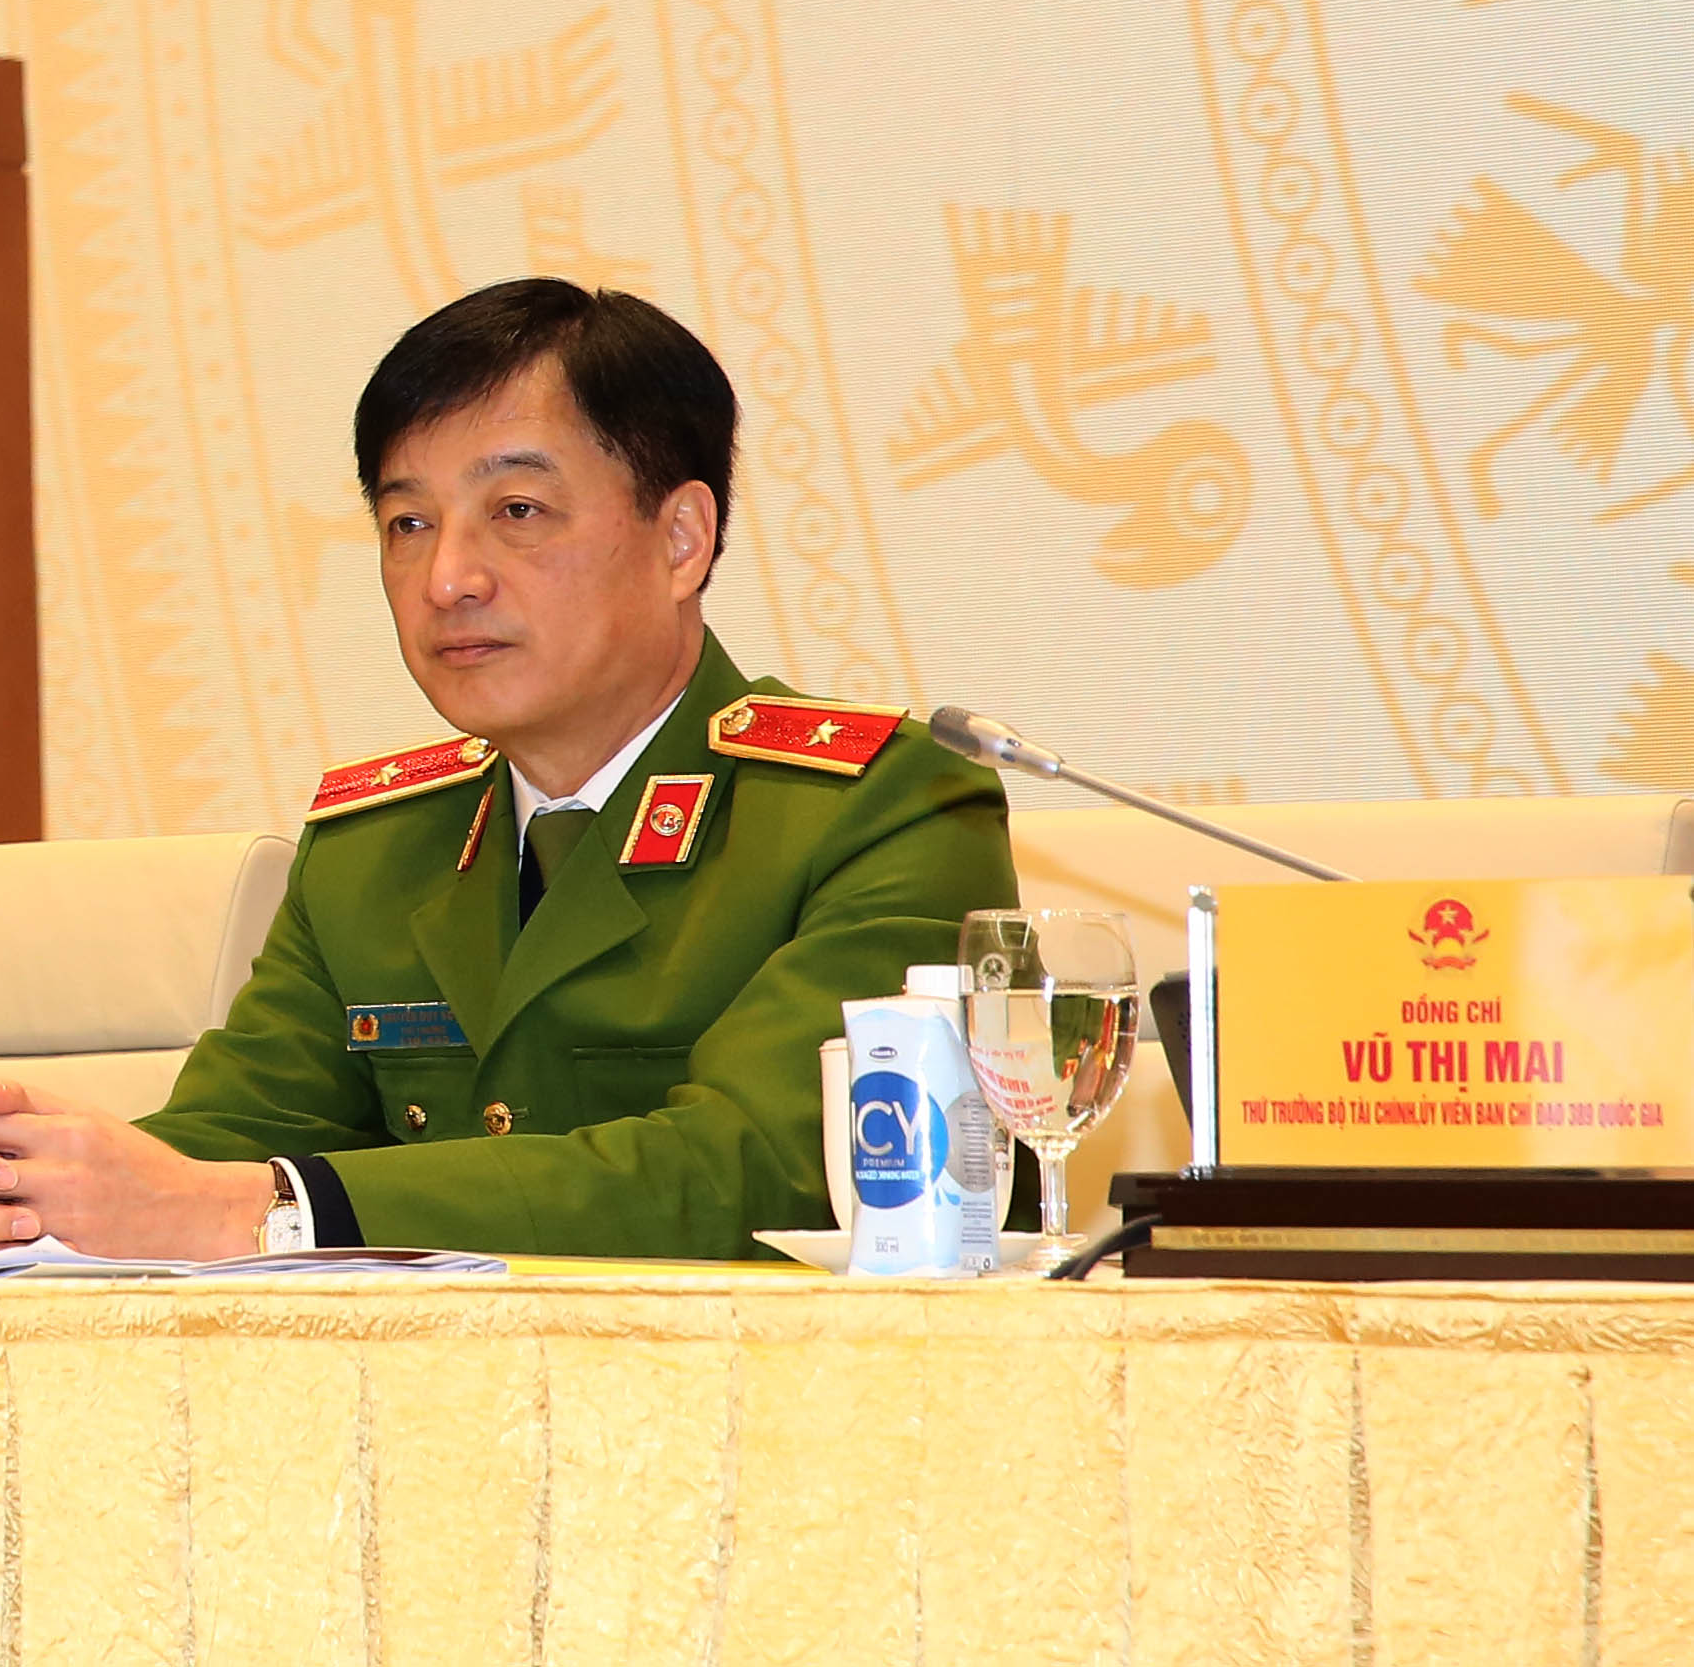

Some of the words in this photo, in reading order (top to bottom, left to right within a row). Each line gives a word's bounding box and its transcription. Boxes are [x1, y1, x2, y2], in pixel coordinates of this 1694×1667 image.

[1466, 995, 1501, 1023] CHÍ
[1342, 1032, 1393, 1083] VŨ
[1406, 1040, 1469, 1092] THỊ
[1484, 1040, 1564, 1083] MAI
